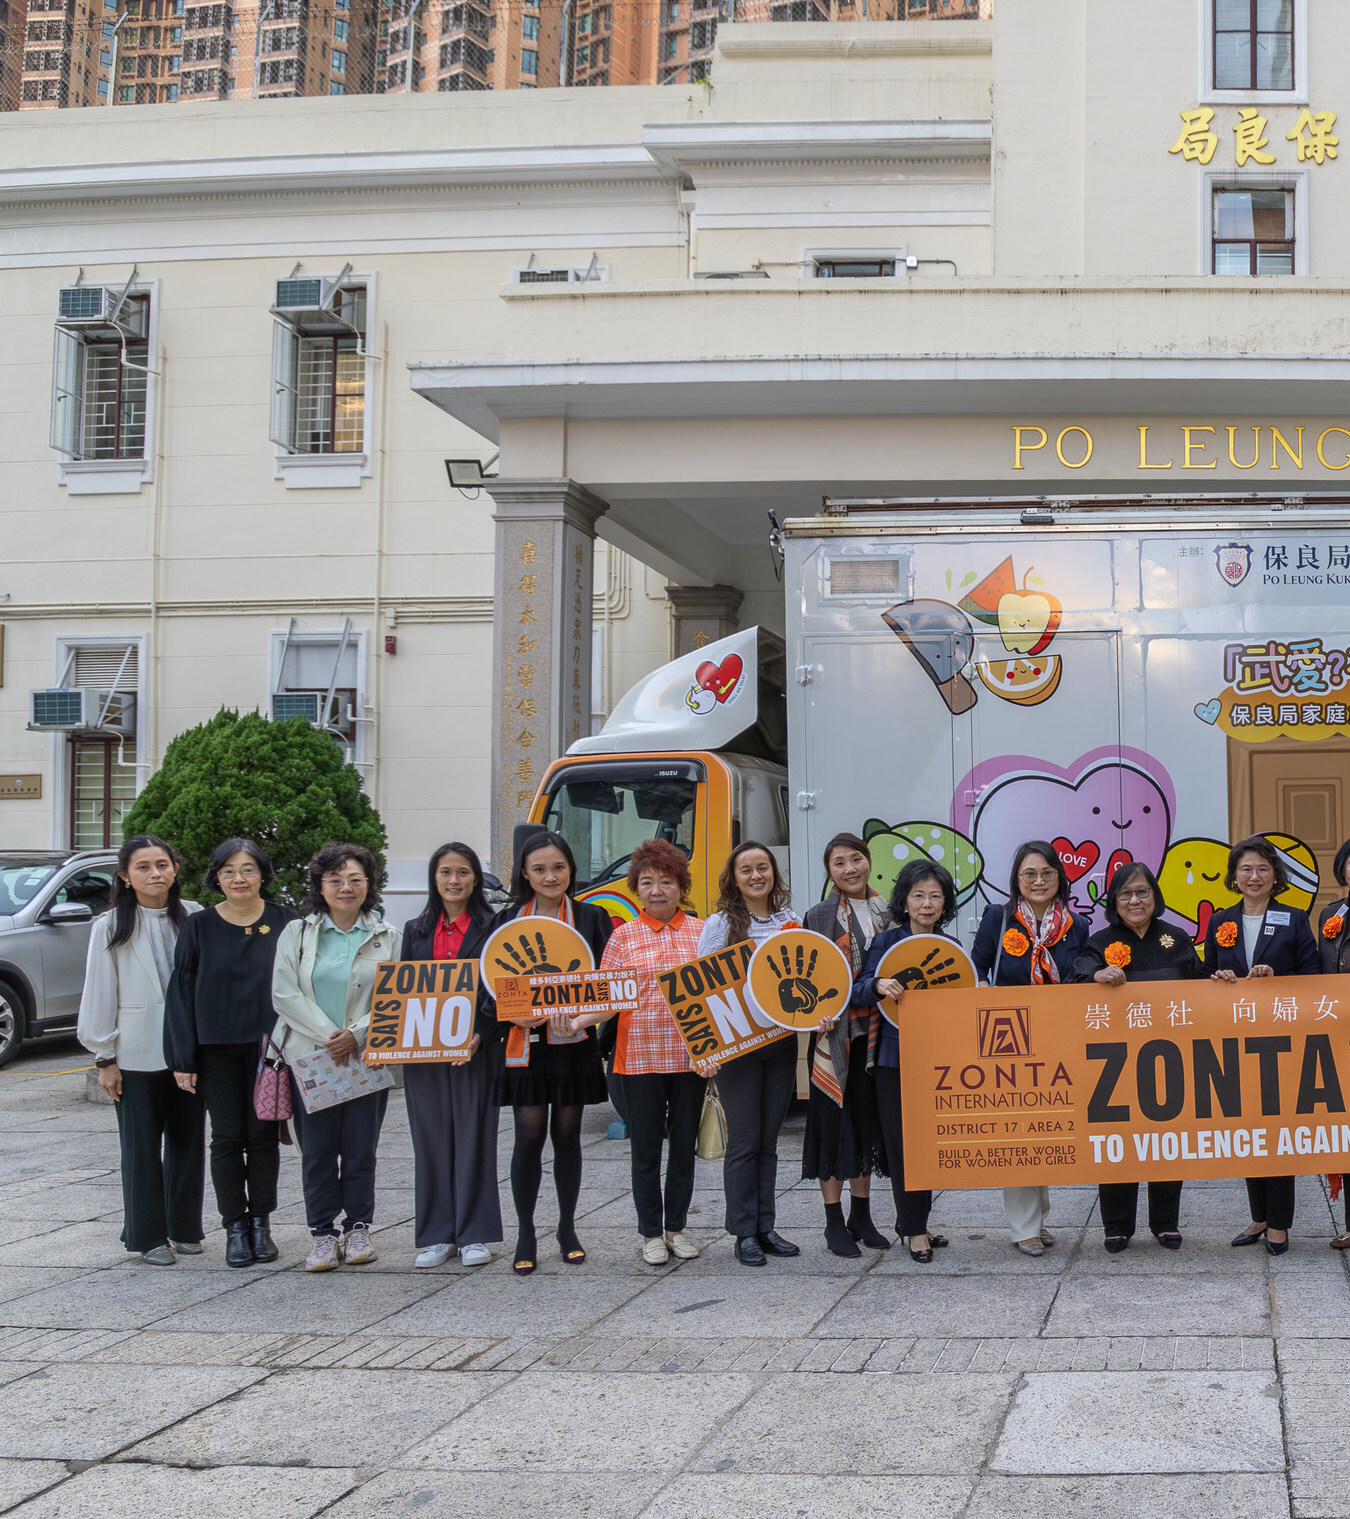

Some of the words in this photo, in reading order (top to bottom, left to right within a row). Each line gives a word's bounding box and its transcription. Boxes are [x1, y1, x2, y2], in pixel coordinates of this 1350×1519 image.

[1011, 425, 1094, 470] PO
[1263, 574, 1280, 585] PO
[1283, 573, 1323, 584] LEUNG
[1058, 851, 1088, 868] LOVE
[376, 962, 474, 994] ZONTA
[530, 982, 597, 1007] ZONTA
[596, 981, 609, 1002] SAYS
[609, 979, 638, 1001] NO
[369, 999, 402, 1048] SAYS
[402, 995, 472, 1048] NO
[532, 1008, 542, 1017] TO
[543, 1006, 578, 1015] VIOLENCE
[579, 1004, 609, 1013] AGAINST
[611, 1001, 638, 1011] WOMEN
[1085, 1000, 1194, 1030] 崇德社
[675, 1003, 719, 1056] SAYS
[368, 1052, 377, 1060] TO
[378, 1051, 411, 1059] VIOLENCE
[412, 1050, 441, 1058] AGAINST
[442, 1049, 468, 1057] WOMEN
[696, 1059, 707, 1068] TO
[706, 1046, 739, 1063] VIOLENCE
[739, 1034, 767, 1049] AGAINST
[934, 1061, 1073, 1091] ZONTA
[1085, 1034, 1346, 1123] ZONTA
[935, 1090, 1074, 1110] INTERNATIONAL
[937, 1122, 997, 1136] DISTRICT
[1004, 1122, 1017, 1133] 17
[1027, 1121, 1062, 1133] AREA
[1067, 1120, 1075, 1131] 2
[938, 1148, 971, 1159] BUILD
[975, 1148, 983, 1158] A
[987, 1147, 1028, 1158] BETTER
[1032, 1145, 1075, 1156] WORLD
[1089, 1134, 1124, 1163] TO
[1133, 1128, 1268, 1162] VIOLENCE
[939, 1159, 962, 1169] FOR
[965, 1157, 1015, 1168] WOMEN
[1017, 1156, 1040, 1167] AND
[1045, 1154, 1076, 1166] GIRLS
